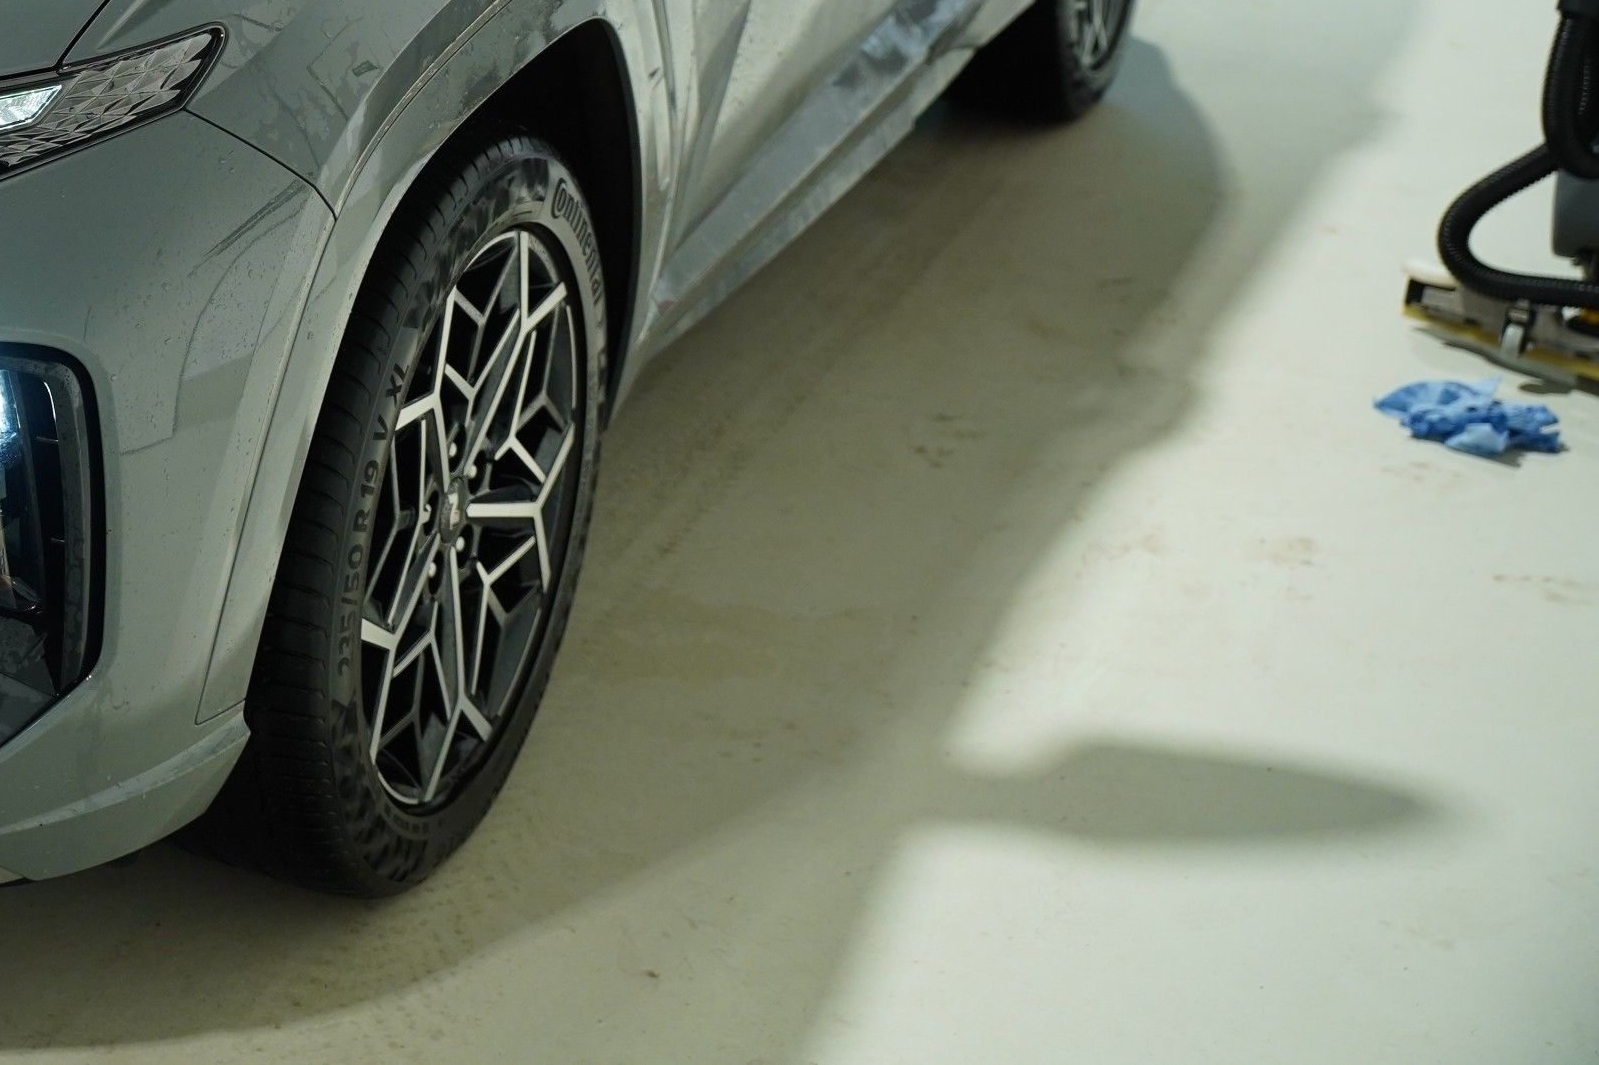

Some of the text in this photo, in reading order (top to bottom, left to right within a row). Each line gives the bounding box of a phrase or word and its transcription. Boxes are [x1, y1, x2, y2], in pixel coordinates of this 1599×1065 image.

[551, 177, 603, 307] Continental
[385, 362, 410, 409] XL
[372, 413, 389, 441] V
[360, 459, 379, 499] 19
[353, 508, 370, 533] R
